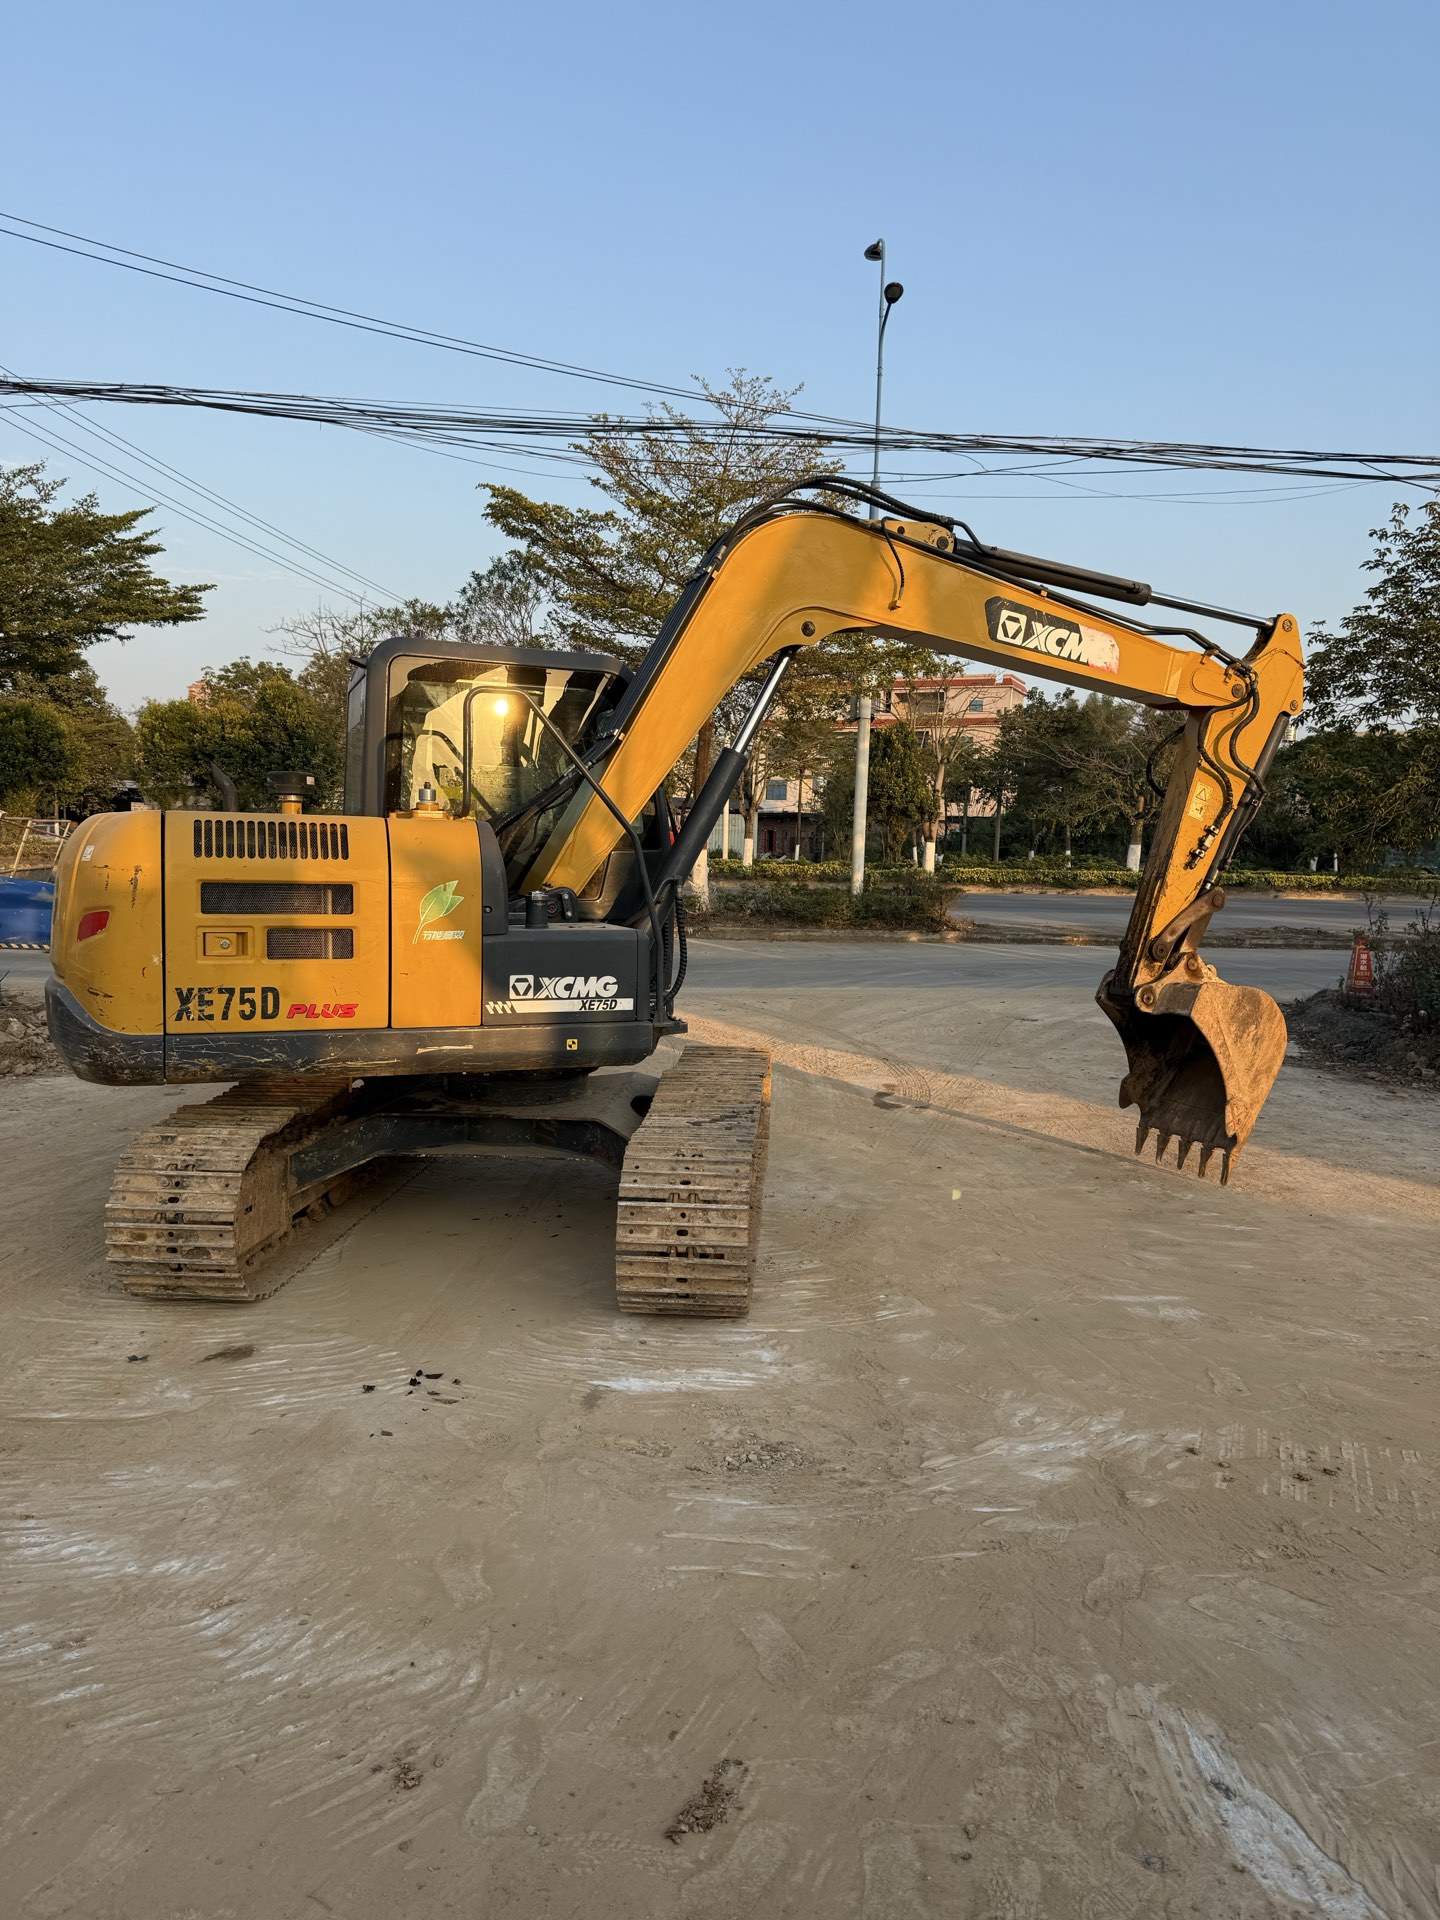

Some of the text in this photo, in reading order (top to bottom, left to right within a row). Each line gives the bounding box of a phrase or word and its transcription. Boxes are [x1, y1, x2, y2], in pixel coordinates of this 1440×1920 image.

[1021, 621, 1104, 667] XCM
[533, 975, 619, 999] XCMG
[174, 986, 360, 1022] XE75D PLUS
[579, 999, 618, 1011] XE75D
